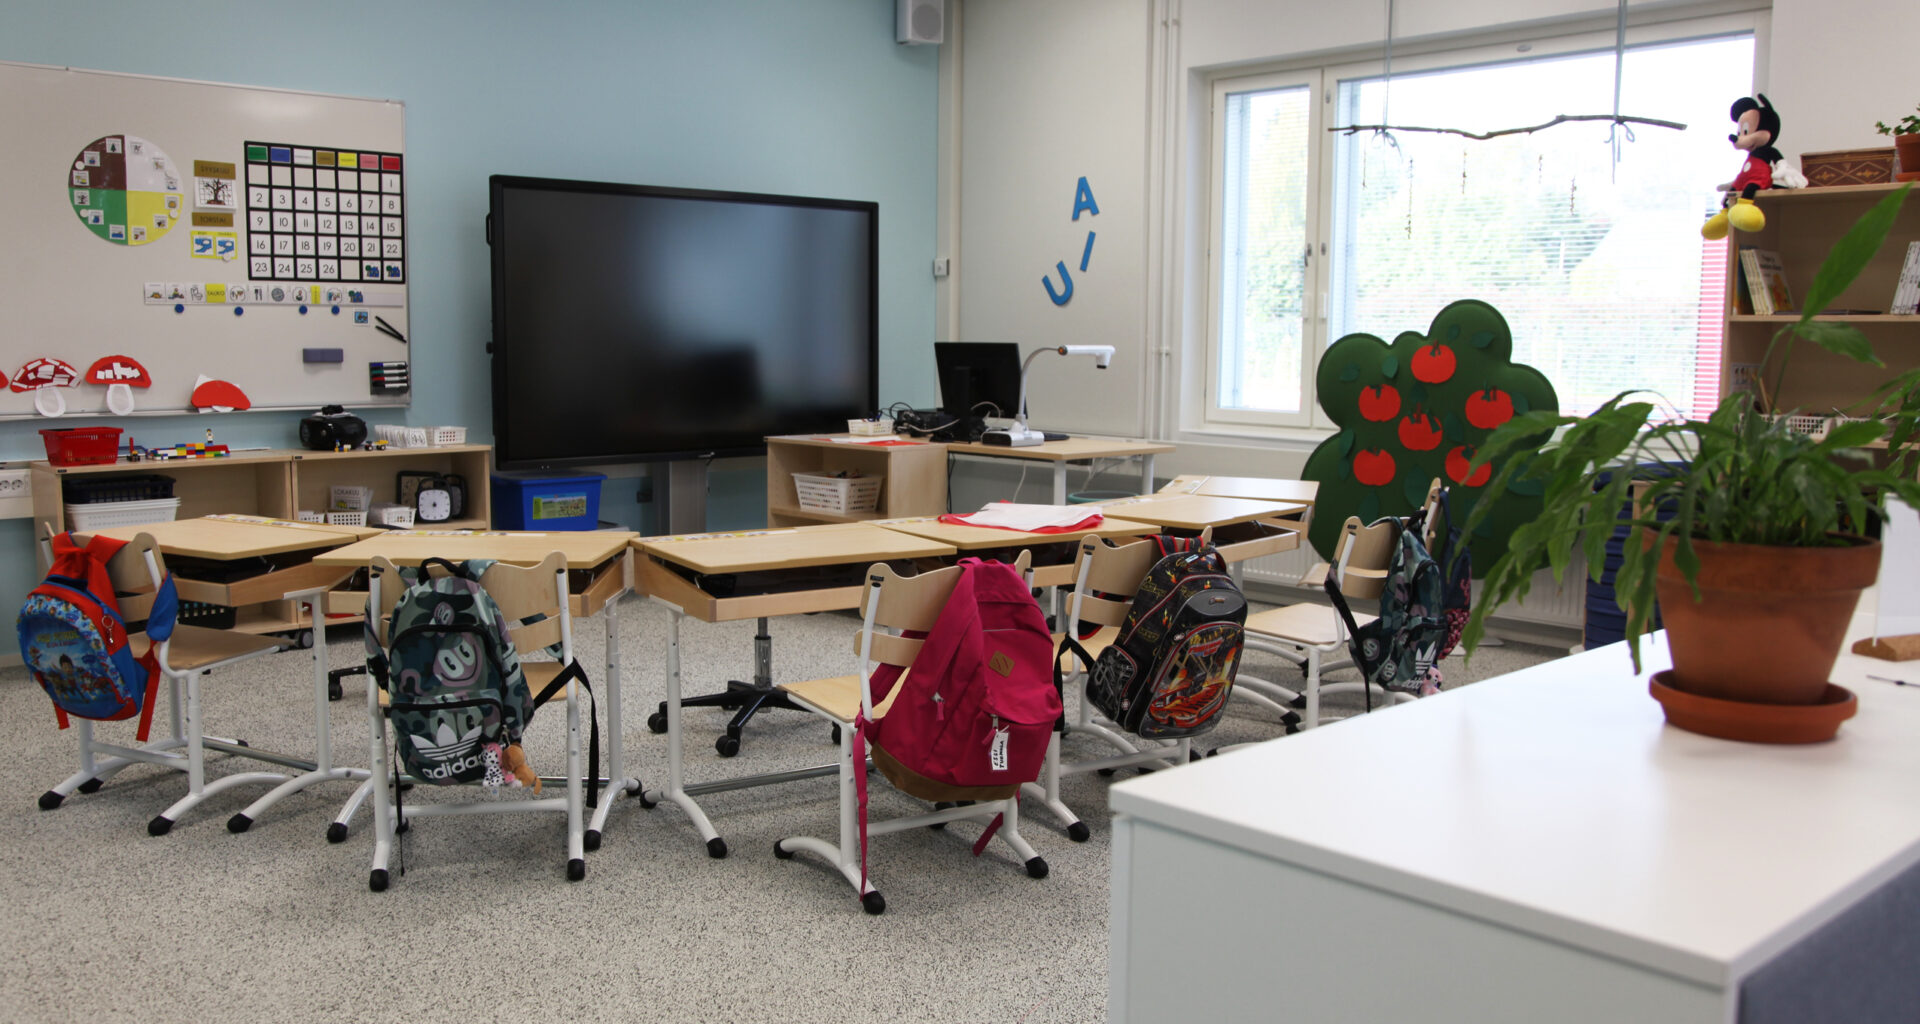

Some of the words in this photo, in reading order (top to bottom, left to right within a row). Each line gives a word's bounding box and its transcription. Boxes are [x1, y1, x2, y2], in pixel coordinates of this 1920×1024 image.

[1072, 176, 1100, 222] A
[279, 216, 289, 228] 10
[303, 218, 309, 228] 11
[323, 218, 333, 230] 12
[344, 220, 354, 231] 13
[366, 221, 375, 231] 14
[386, 222, 396, 233] 15
[256, 239, 266, 250] 16
[279, 240, 289, 251] 17
[301, 240, 311, 251] 18
[323, 241, 332, 252] 19
[343, 242, 357, 253] 20
[367, 242, 376, 253] 21
[386, 243, 398, 255] 22
[1080, 231, 1096, 272] I
[254, 262, 268, 273] 23
[278, 263, 291, 274] 24
[300, 263, 313, 274] 25
[322, 263, 336, 275] 26
[1042, 260, 1074, 306] U
